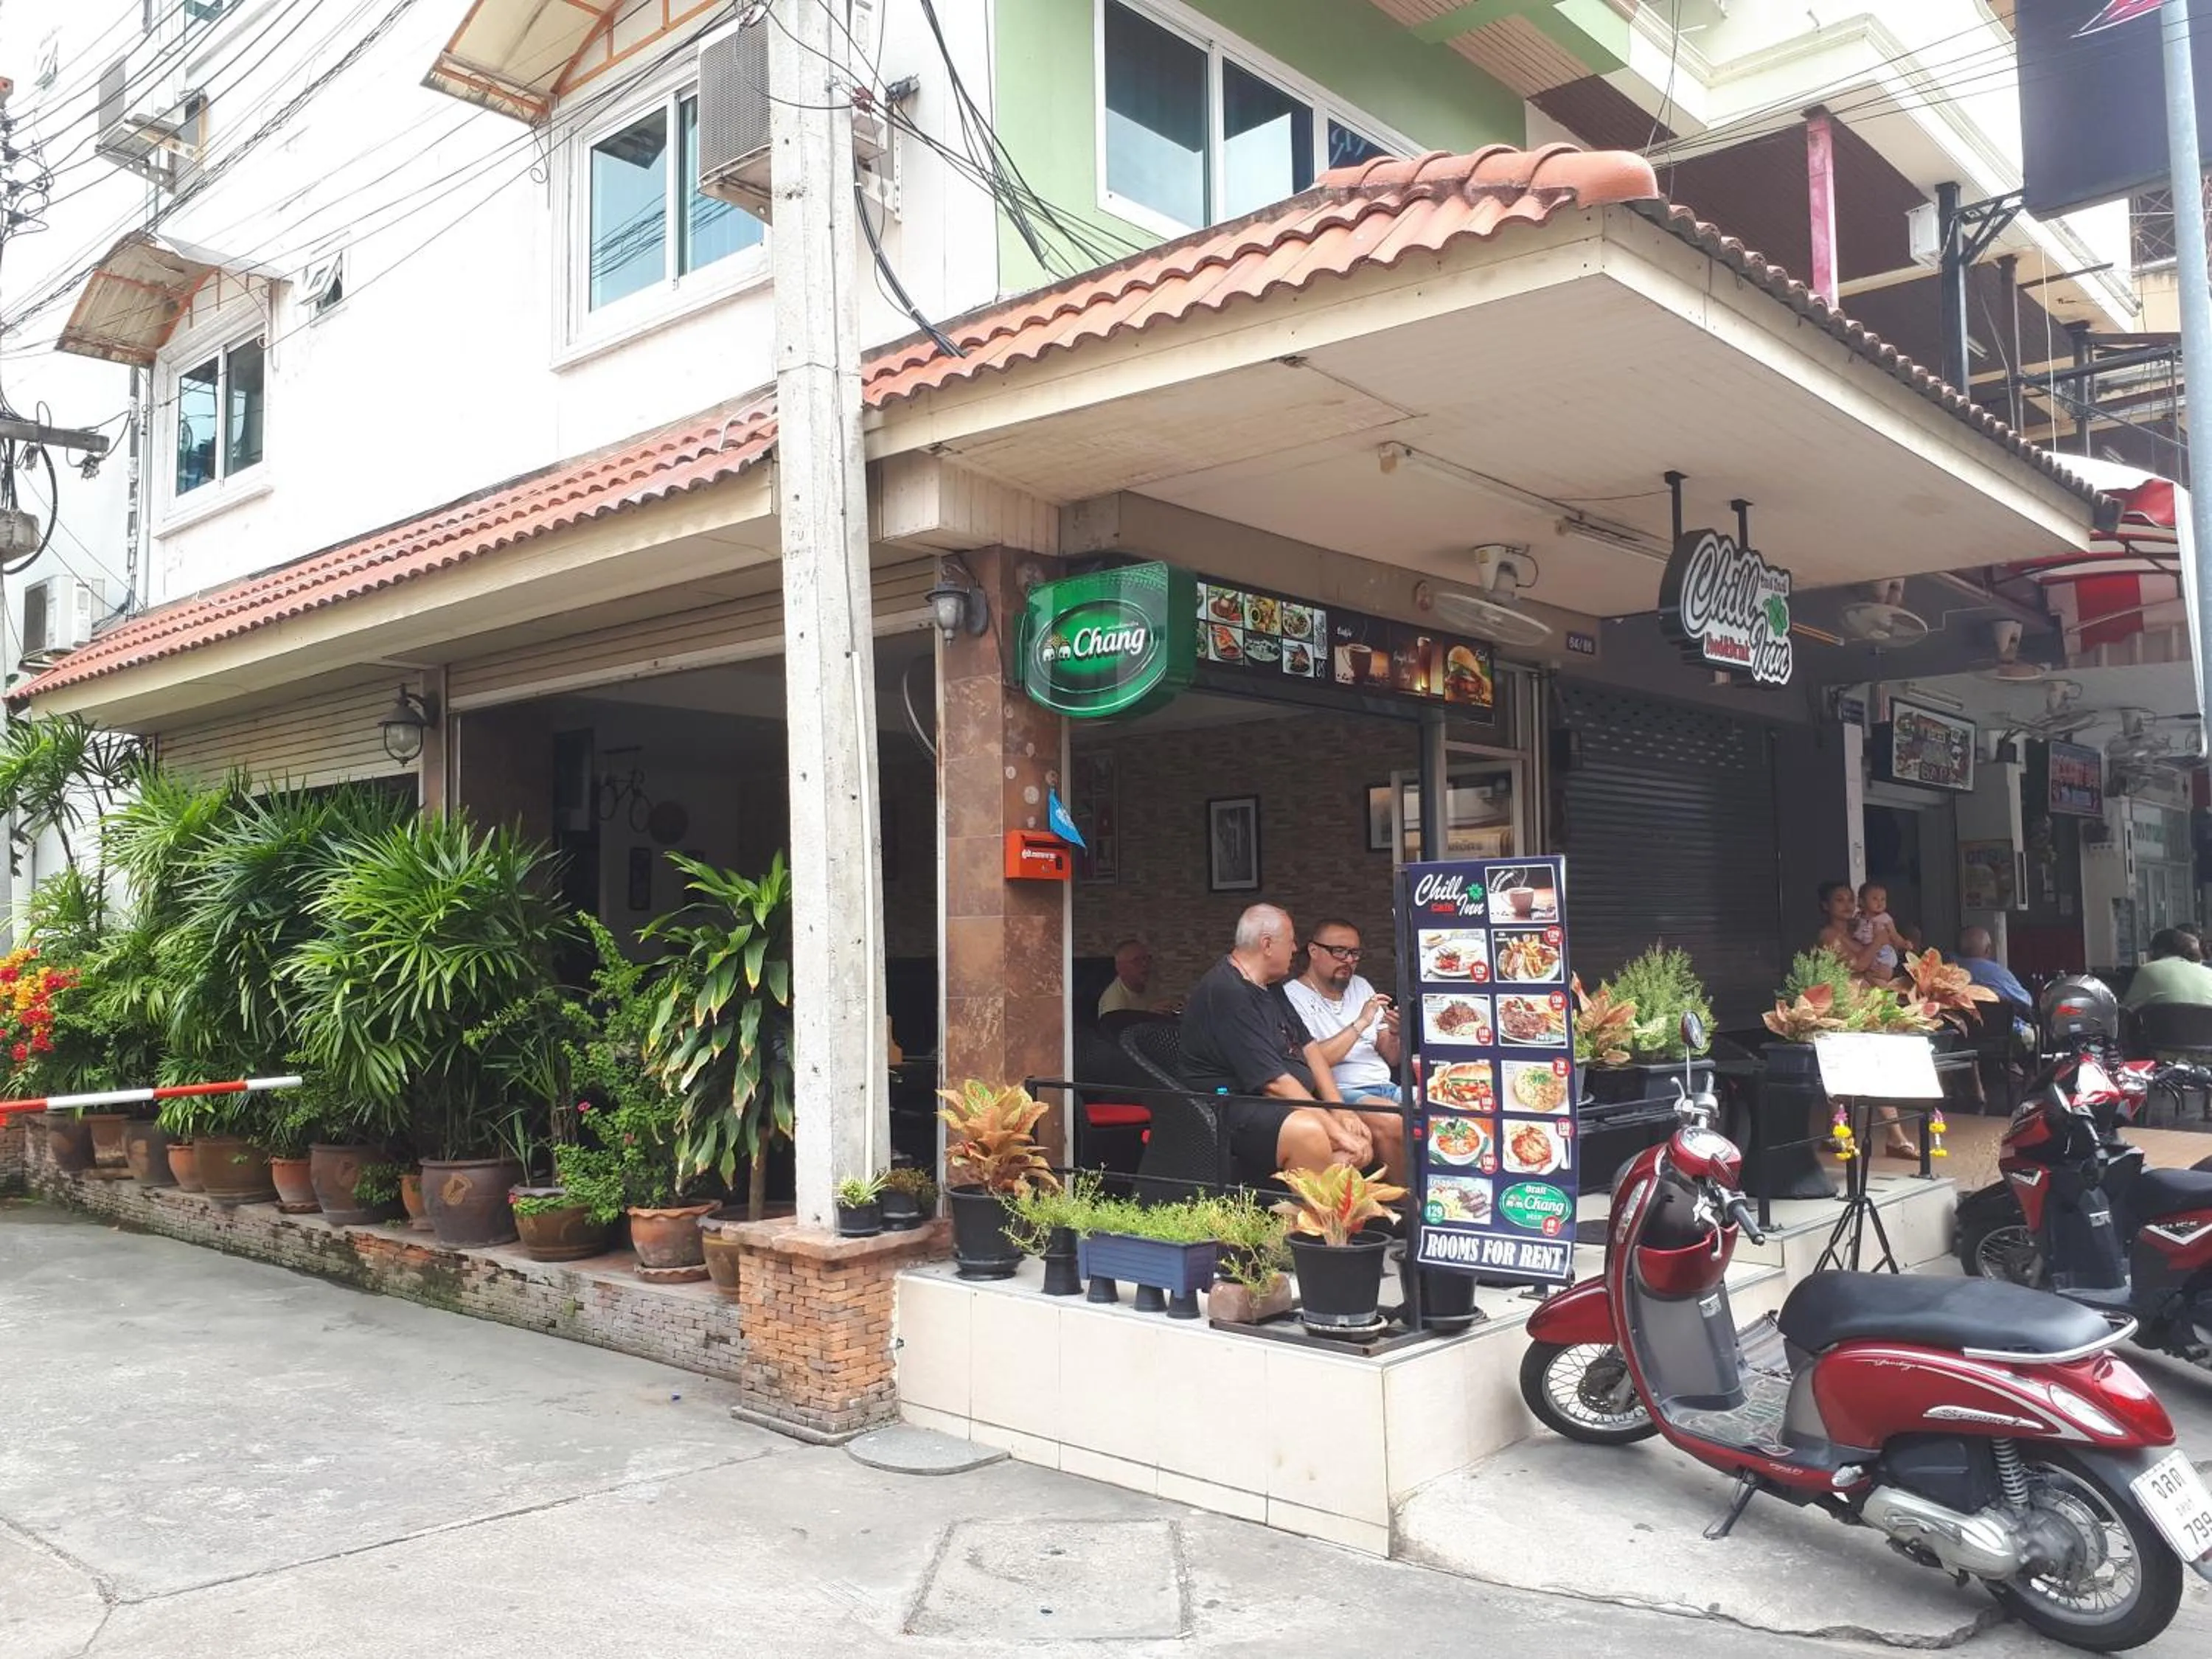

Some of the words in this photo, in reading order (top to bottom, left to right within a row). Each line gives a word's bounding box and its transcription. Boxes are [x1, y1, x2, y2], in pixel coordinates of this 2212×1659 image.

[1683, 540, 1761, 635] Chill
[1073, 626, 1146, 658] Chang
[1750, 613, 1790, 678] Inn
[1414, 874, 1463, 906] Chill
[1457, 893, 1484, 916] Inn
[1427, 1205, 1443, 1217] 129
[1524, 1194, 1565, 1215] Chang
[1426, 1234, 1479, 1262] ROOMS
[1481, 1240, 1516, 1266] FOR
[1519, 1244, 1564, 1270] RENT
